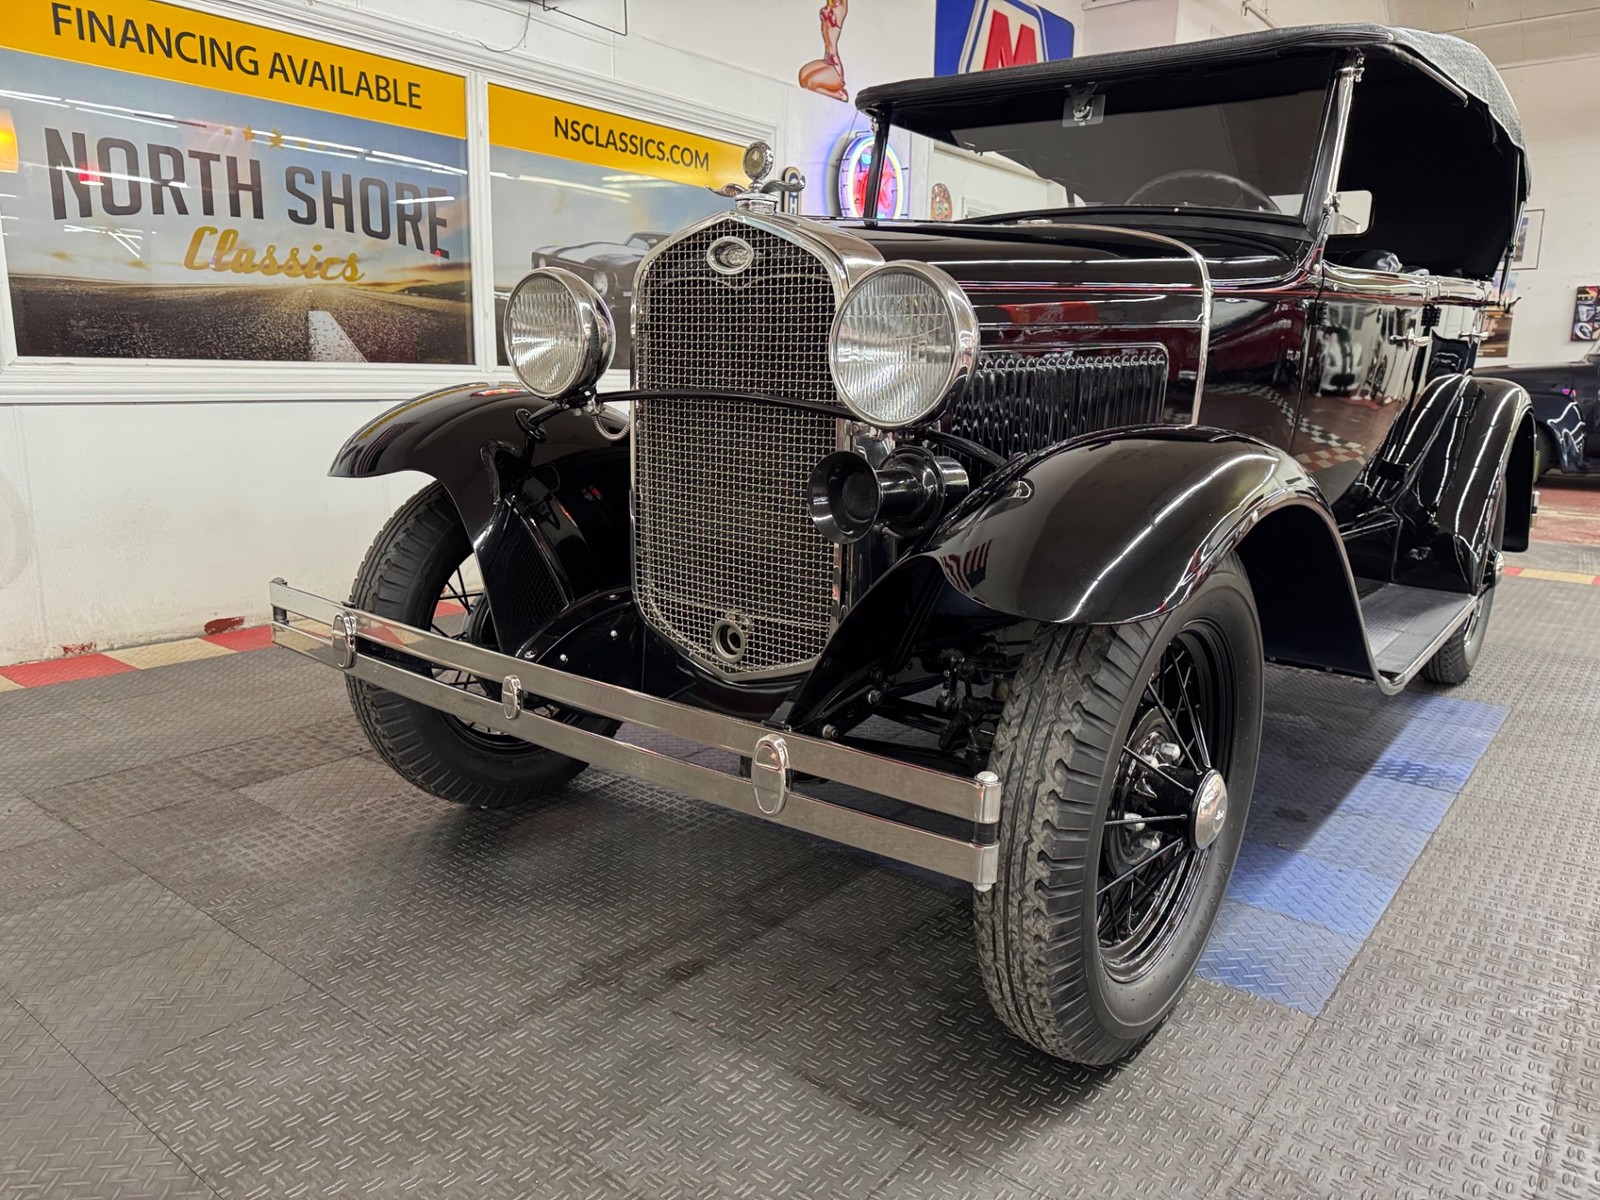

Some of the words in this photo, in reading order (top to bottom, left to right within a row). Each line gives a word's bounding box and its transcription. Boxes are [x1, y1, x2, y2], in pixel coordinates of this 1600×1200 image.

[52, 2, 259, 76] FINANCING
[268, 51, 422, 110] AVAILABLE
[983, 9, 1037, 71] M
[554, 116, 709, 171] NSCLASSICS.COM
[44, 127, 264, 221] NORTH
[285, 166, 450, 260] SHORE
[183, 226, 365, 283] Classics
